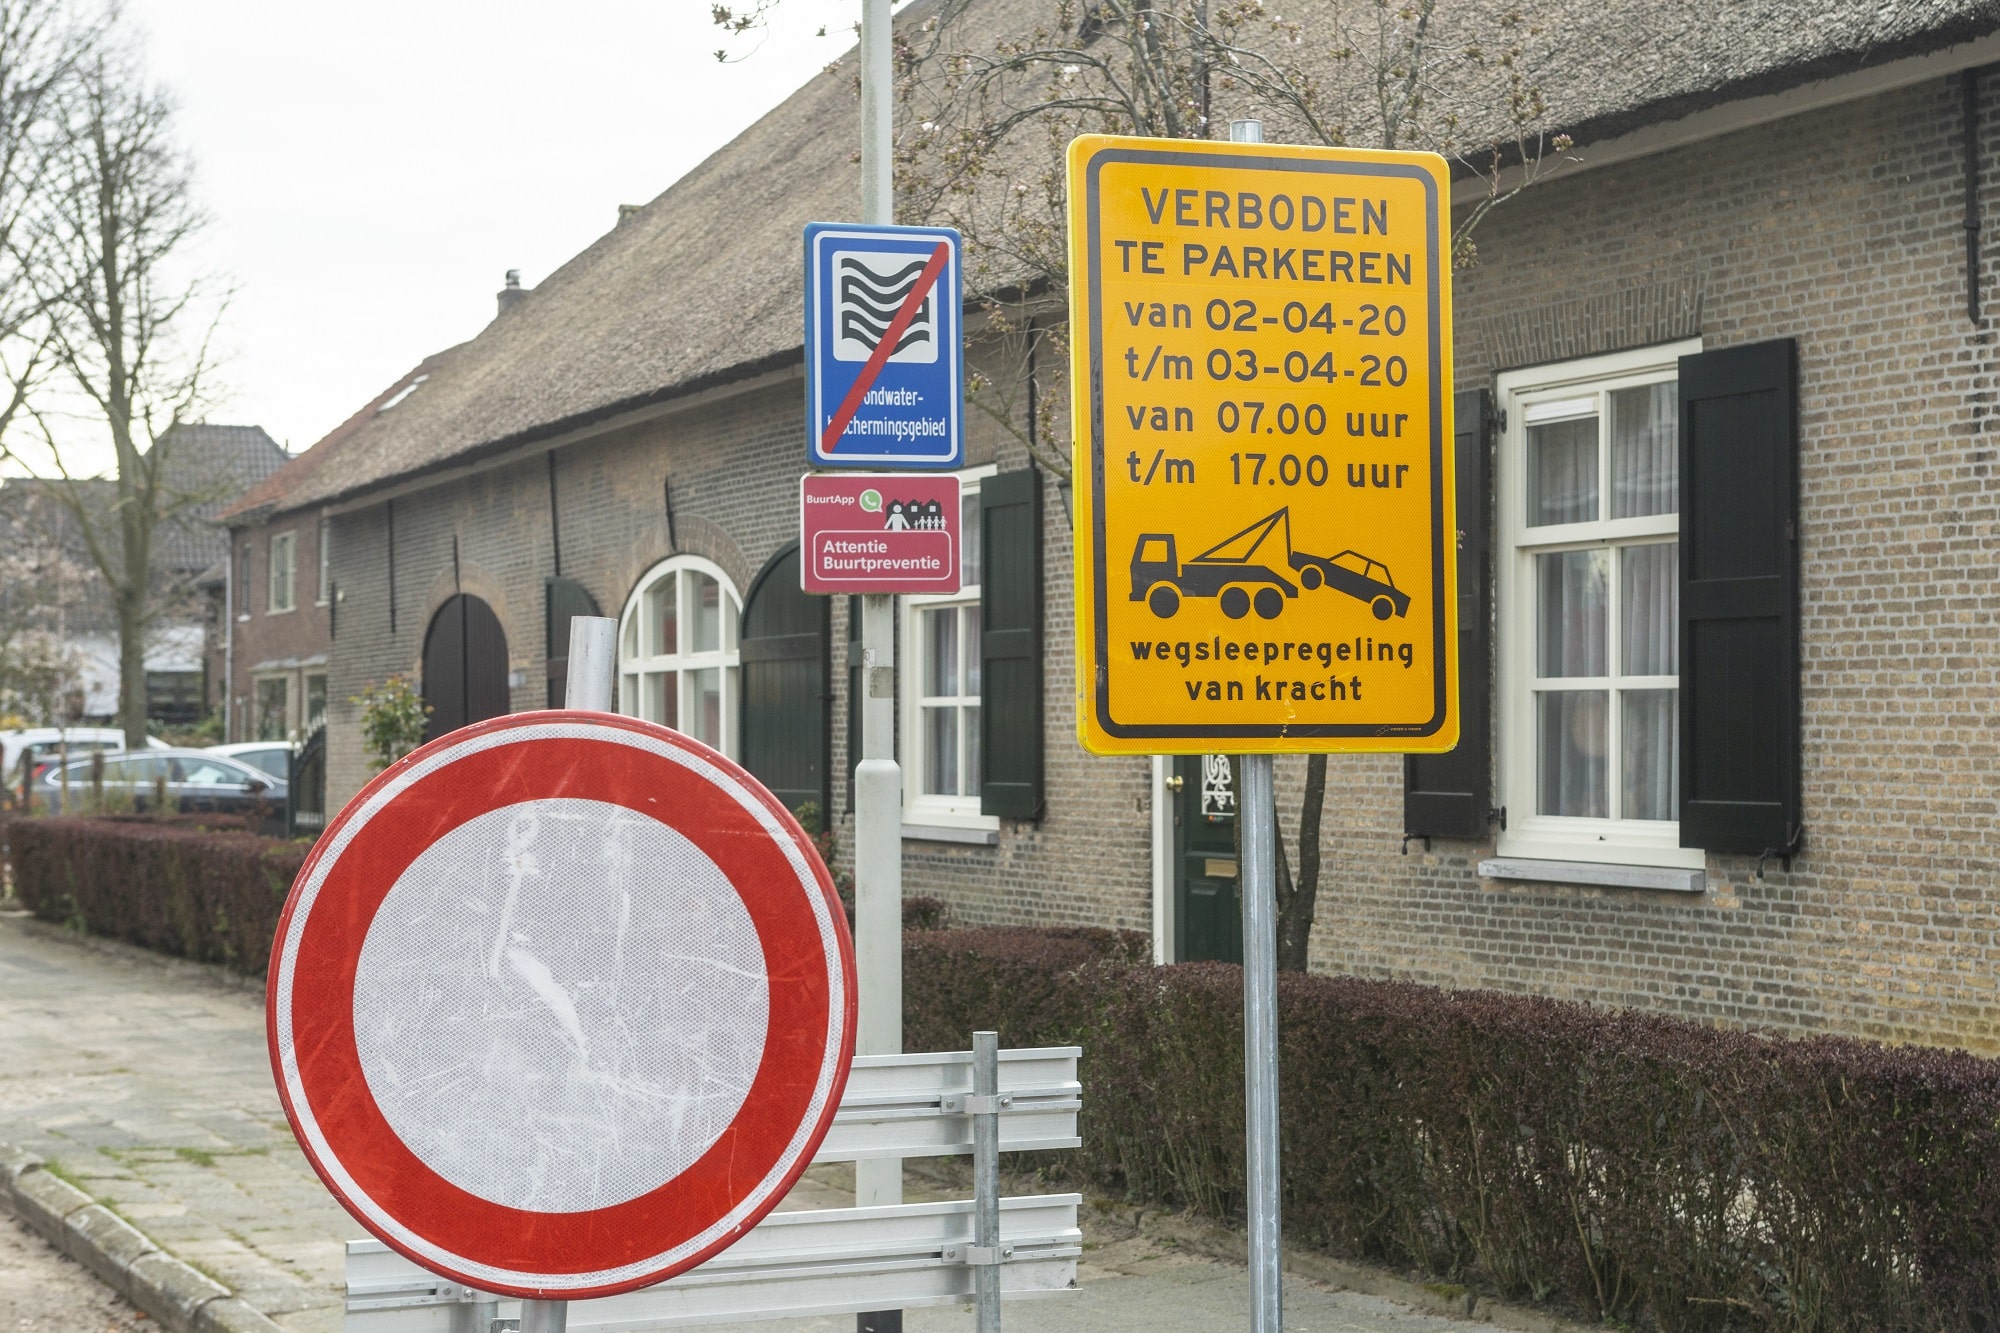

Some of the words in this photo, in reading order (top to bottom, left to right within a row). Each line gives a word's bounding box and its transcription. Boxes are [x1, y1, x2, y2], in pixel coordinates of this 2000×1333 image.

[1140, 187, 1388, 236] VERBODEN
[1114, 239, 1165, 275] TE
[1183, 243, 1412, 286] PARKEREN
[1124, 301, 1192, 329] van
[1205, 298, 1406, 337] 02-04-20
[1124, 345, 1193, 382] t/m
[1206, 348, 1408, 388] 03-04-20
[863, 386, 924, 406] ondwater-
[827, 415, 946, 442] chermingsgebied
[1126, 405, 1194, 432] van
[1217, 400, 1327, 436] 07.00
[1346, 412, 1409, 438] uur
[1126, 448, 1195, 486] t/m
[1230, 452, 1329, 487] 17.00
[1347, 463, 1410, 489] uur
[806, 494, 855, 506] BuurtApp
[823, 539, 888, 553] Attentie
[823, 555, 941, 573] Buurtpreventie
[1129, 635, 1414, 669] wegsleepregeling
[1184, 680, 1244, 701] van
[1254, 674, 1363, 701] kracht
